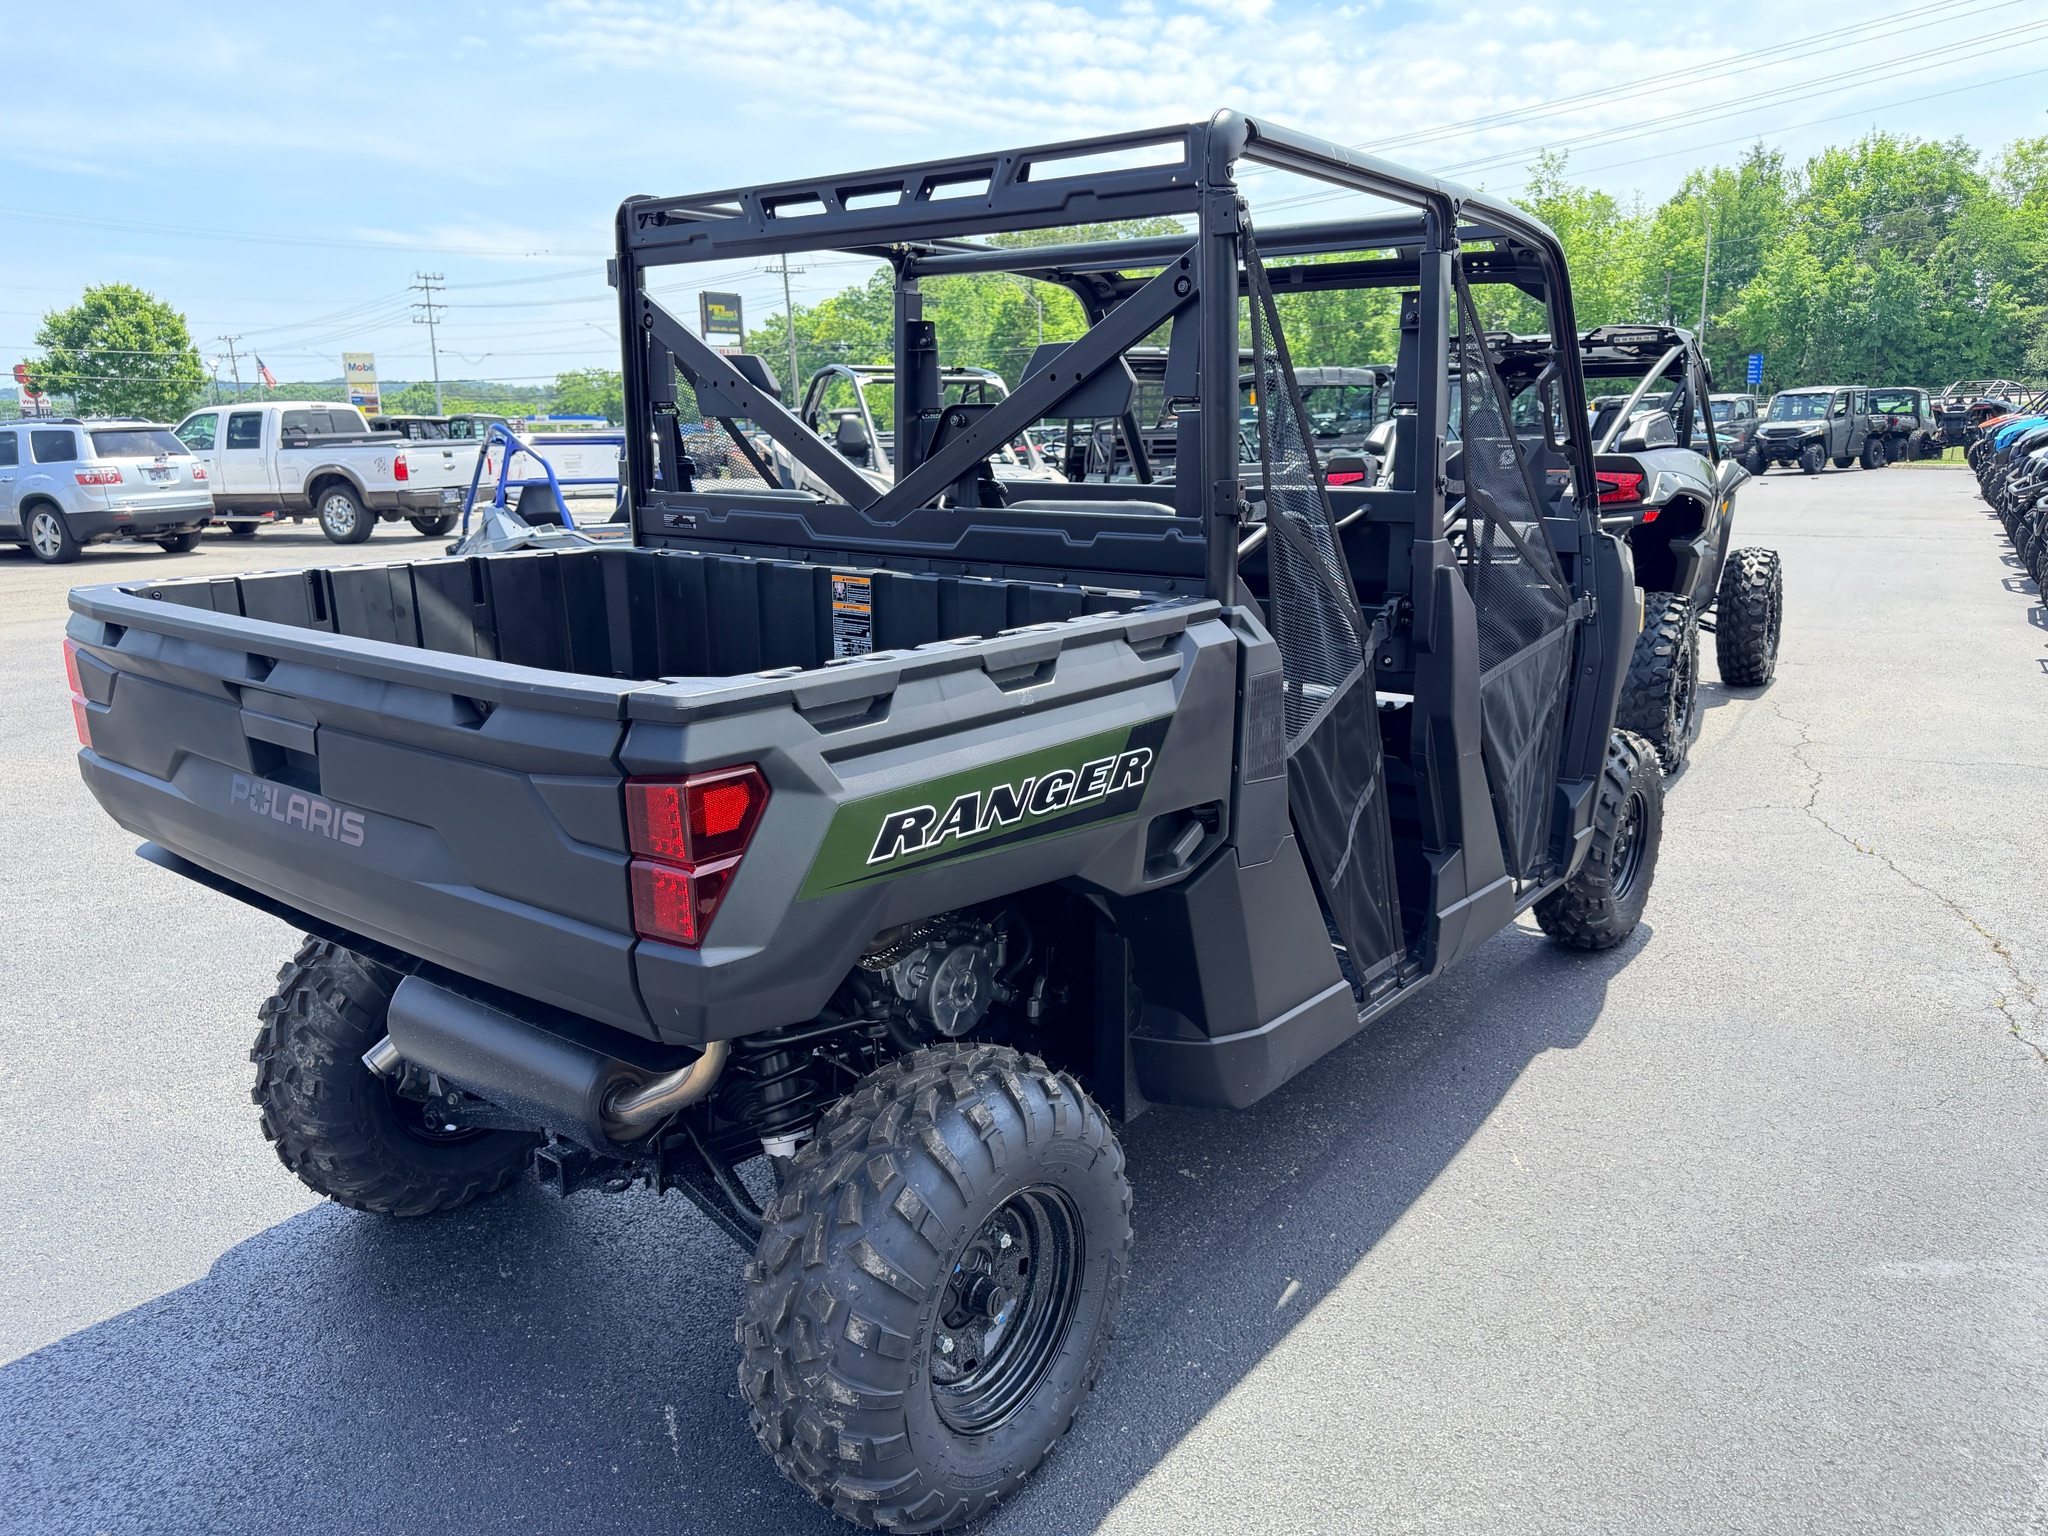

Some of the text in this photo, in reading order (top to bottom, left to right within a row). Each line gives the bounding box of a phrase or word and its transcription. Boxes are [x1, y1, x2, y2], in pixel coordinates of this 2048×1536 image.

[348, 362, 374, 371] Mobil
[230, 772, 365, 847] POLARIS
[866, 747, 1152, 865] RANGER
